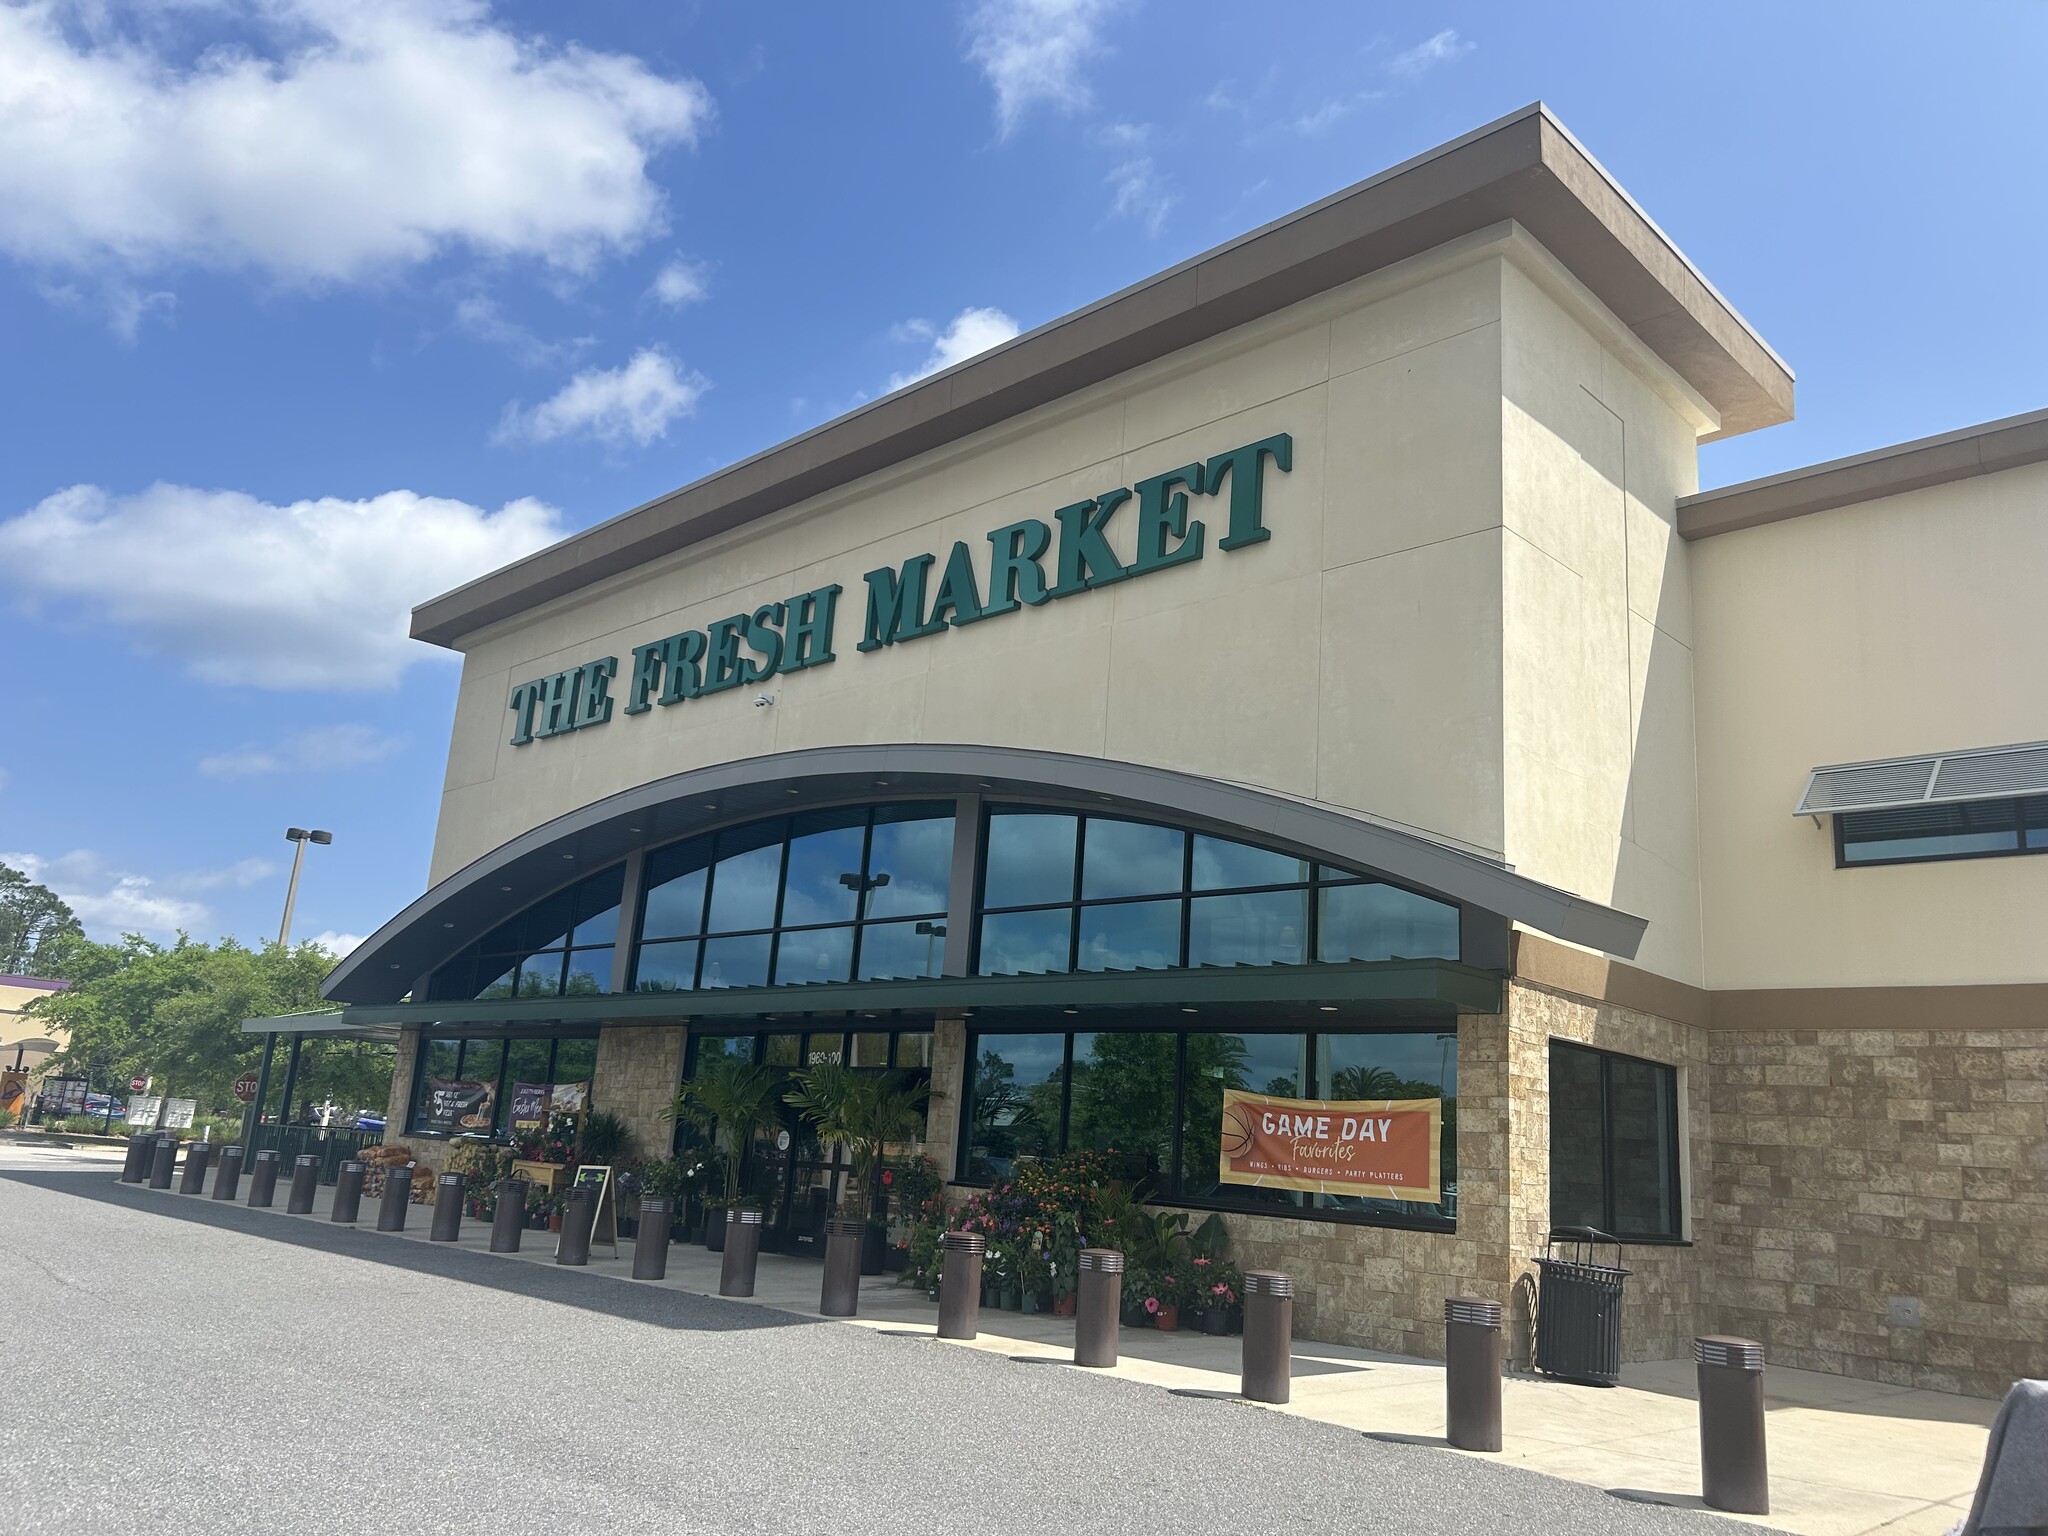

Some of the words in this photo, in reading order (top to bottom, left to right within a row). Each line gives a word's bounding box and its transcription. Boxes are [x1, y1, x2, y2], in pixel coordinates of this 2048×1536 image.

[510, 655, 618, 747] THE
[624, 583, 843, 715] FRESH
[856, 432, 1293, 653] MARKET
[236, 1080, 258, 1093] STO
[433, 1090, 446, 1116] $5
[1261, 1112, 1331, 1139] GAME
[1341, 1117, 1392, 1143] DAY
[1290, 1134, 1356, 1163] Favorites
[1250, 1161, 1268, 1169] WINGS
[1277, 1163, 1292, 1172] RIBS
[1303, 1166, 1333, 1176] BURGERS
[1345, 1169, 1366, 1178] PARTY
[1369, 1171, 1404, 1181] PLATTERS
